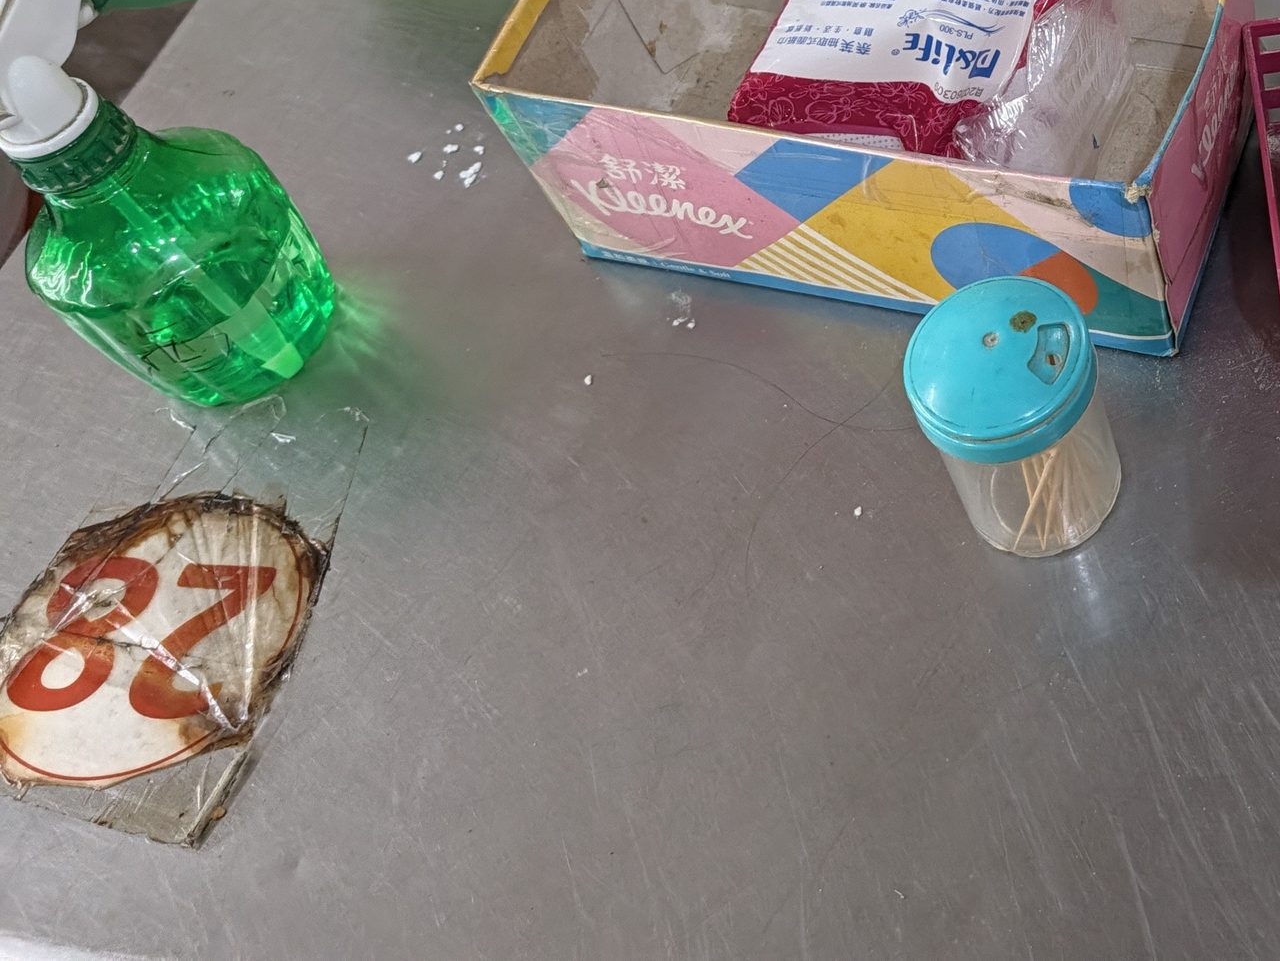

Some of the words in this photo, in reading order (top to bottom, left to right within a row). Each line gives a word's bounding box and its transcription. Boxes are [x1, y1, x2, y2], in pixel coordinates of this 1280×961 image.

[939, 23, 975, 40] PLS-300
[600, 153, 687, 190] 舒潔
[570, 178, 753, 239] Kleenex
